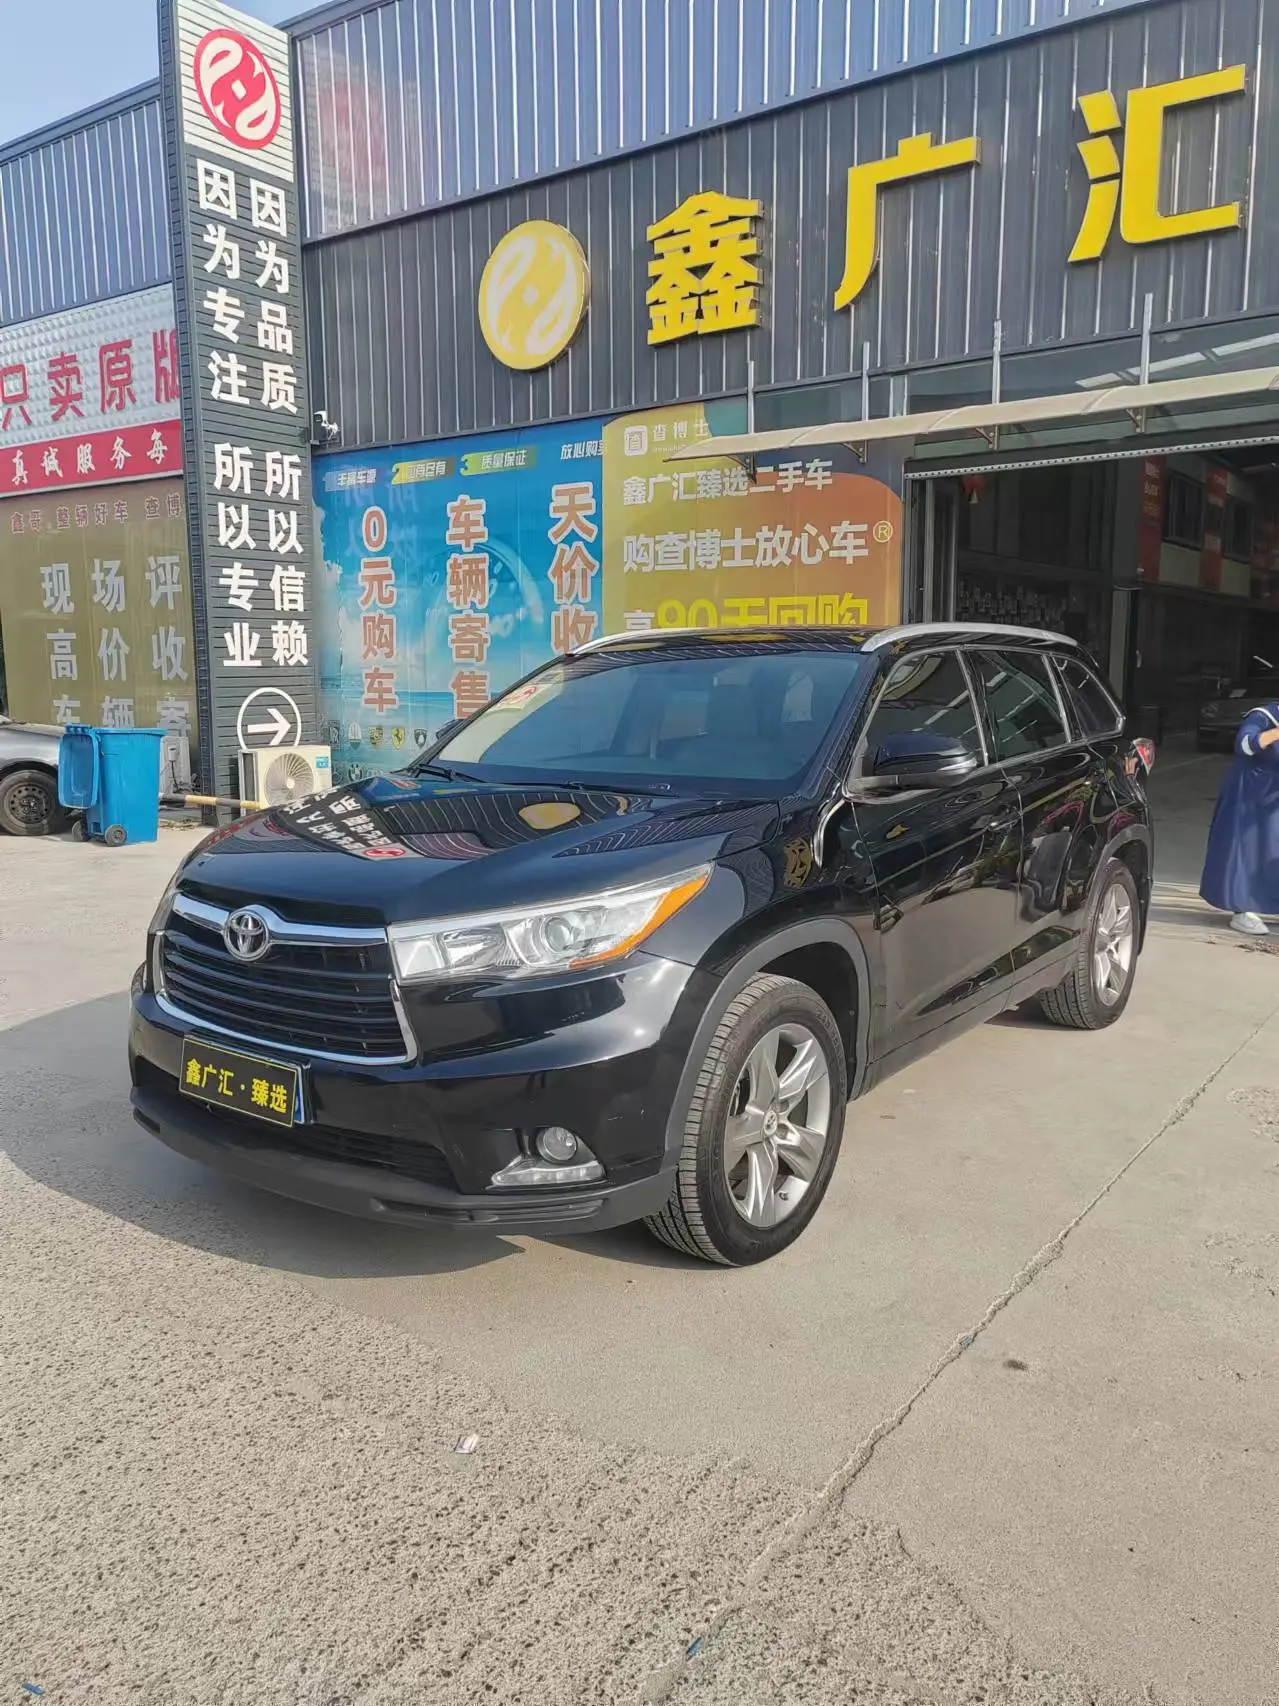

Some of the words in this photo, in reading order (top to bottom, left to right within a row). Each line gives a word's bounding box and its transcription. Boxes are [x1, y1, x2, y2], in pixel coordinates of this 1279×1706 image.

[197, 158, 250, 405] 因为专注
[250, 178, 298, 414] 因为品质
[646, 64, 1247, 346] 鑫广汇
[11, 429, 168, 486] 真诚服务每
[213, 442, 262, 668] 所以专业
[264, 450, 309, 667] 所以信赖
[623, 458, 833, 506] 鑫广汇臻选二手车
[623, 520, 869, 573] 购查博士放心车
[40, 555, 183, 615] 现场评
[46, 625, 188, 682] 高价收
[357, 505, 401, 716] 0元购车
[446, 495, 491, 720] 车辆寄售
